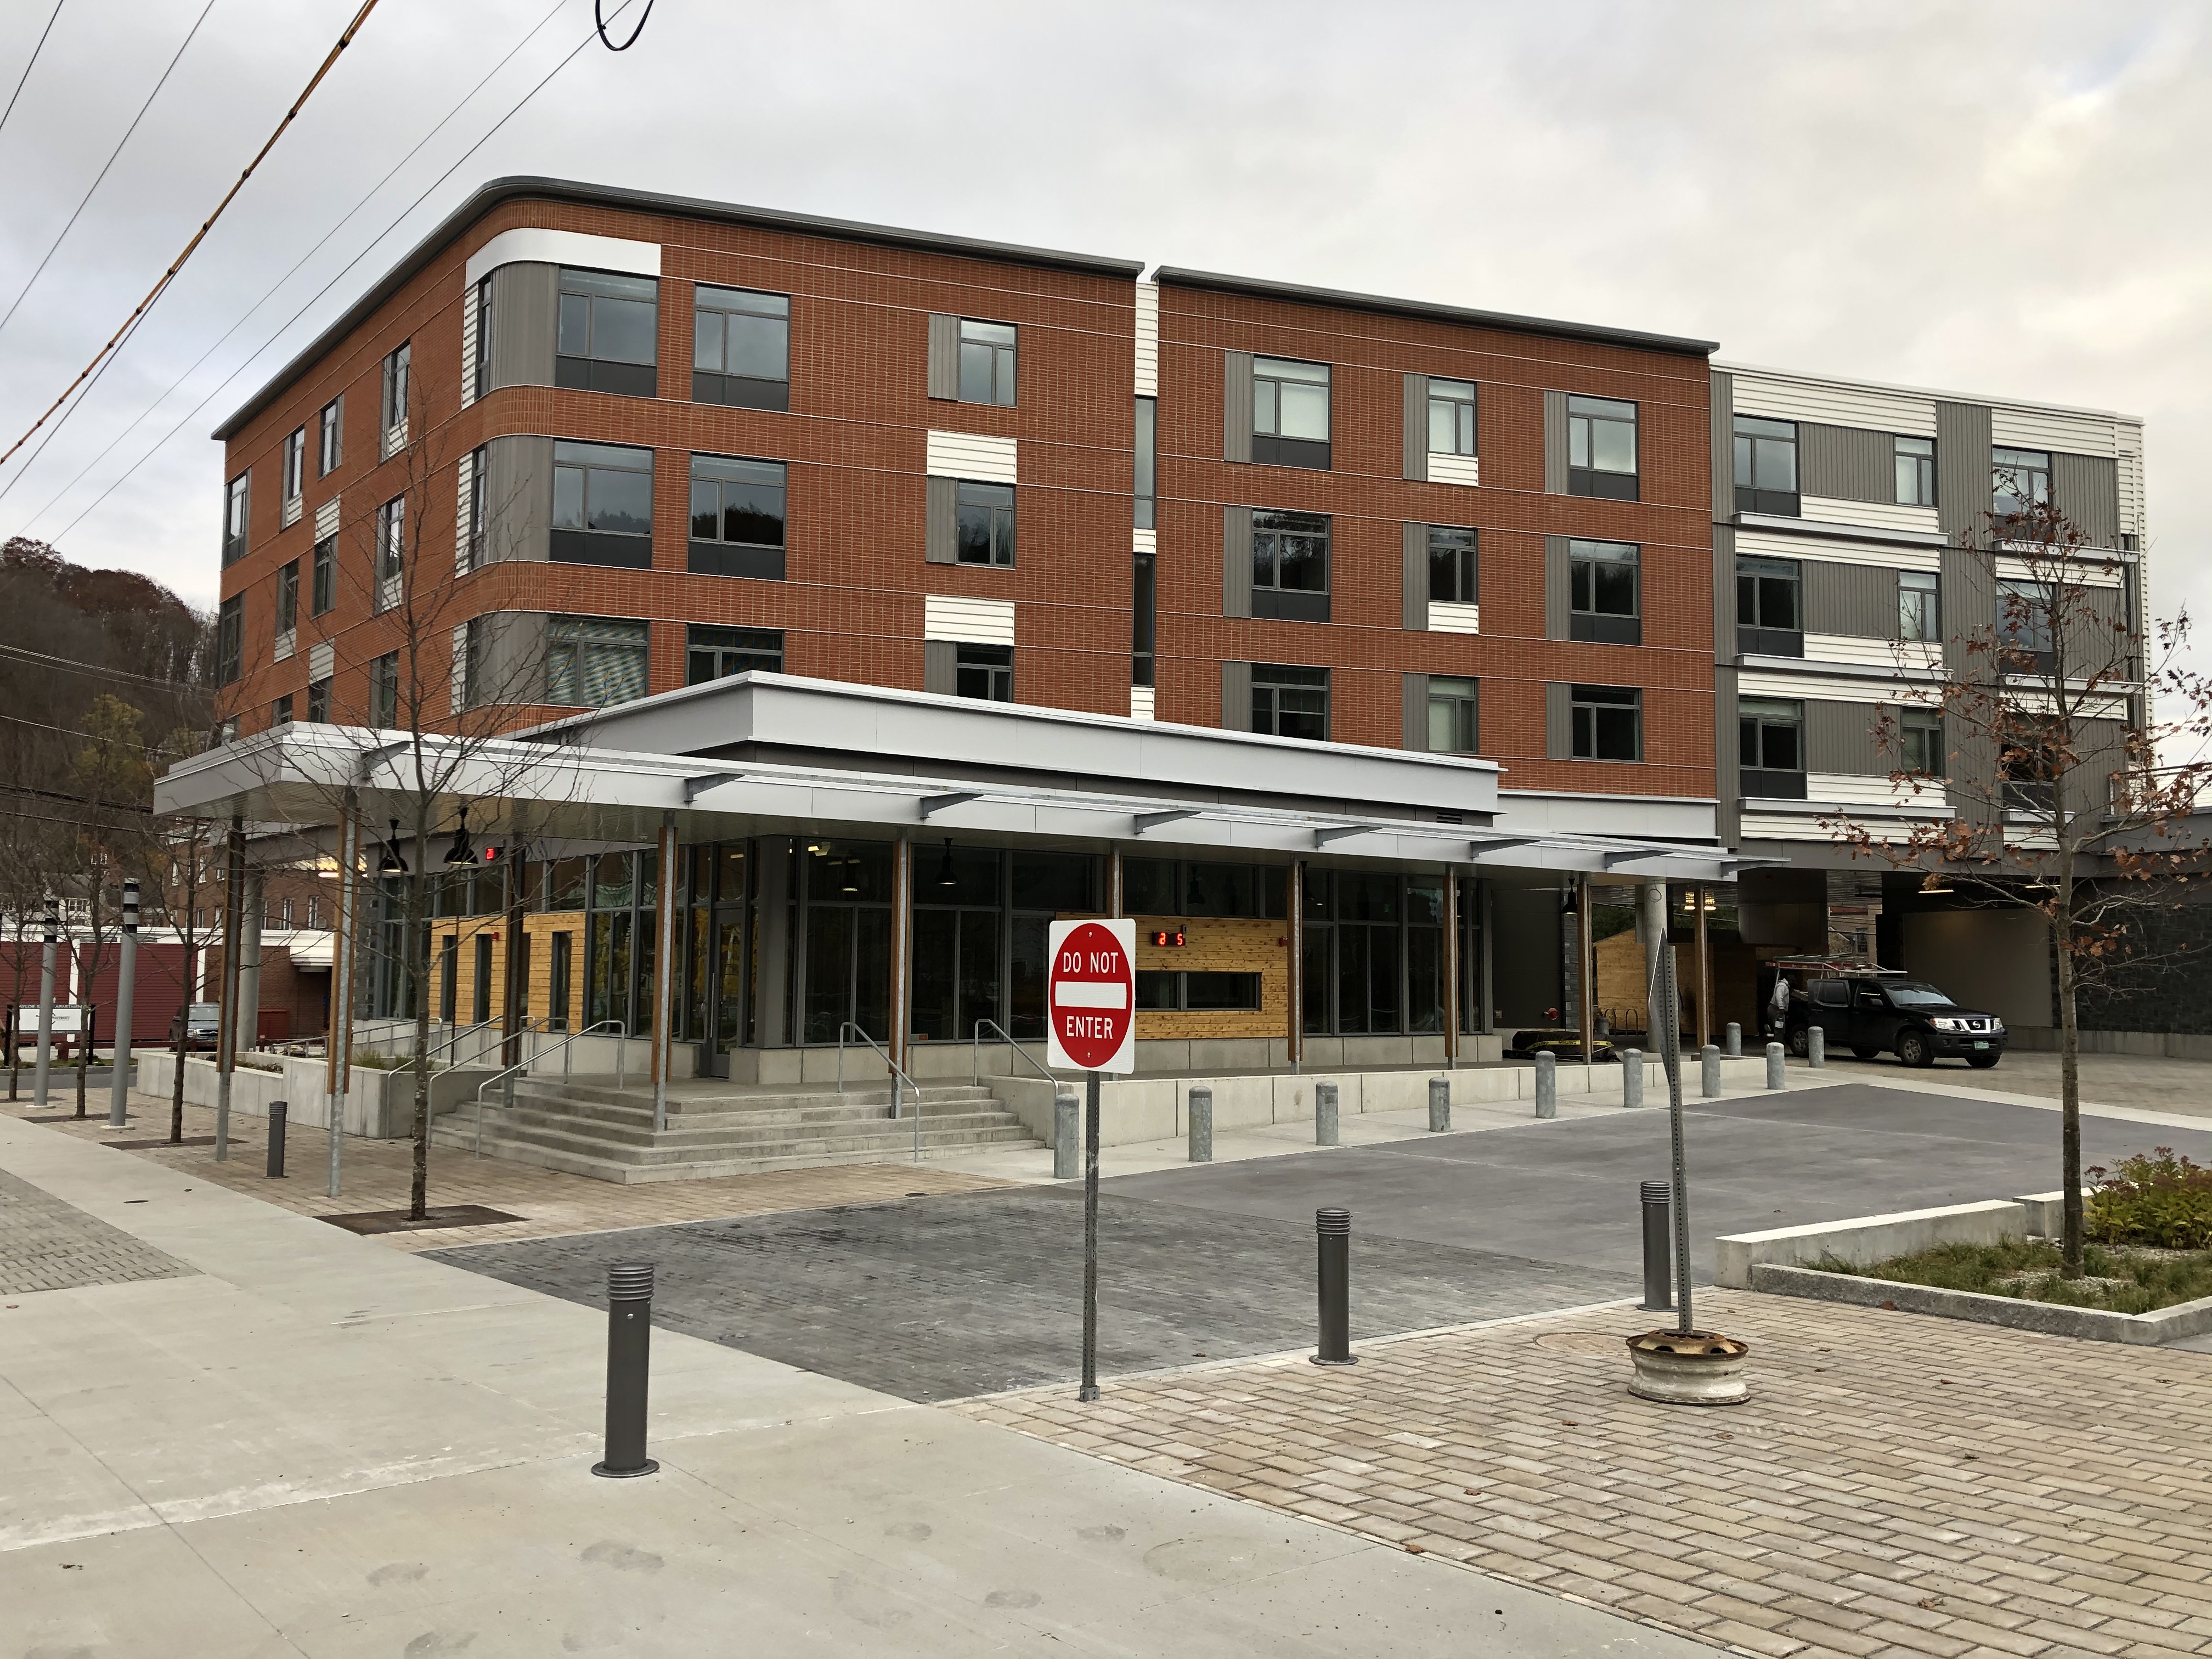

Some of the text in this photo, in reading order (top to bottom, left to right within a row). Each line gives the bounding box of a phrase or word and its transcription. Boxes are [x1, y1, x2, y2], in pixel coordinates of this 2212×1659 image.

[1063, 952, 1119, 974] DO NOT
[1066, 1016, 1113, 1039] ENTER
